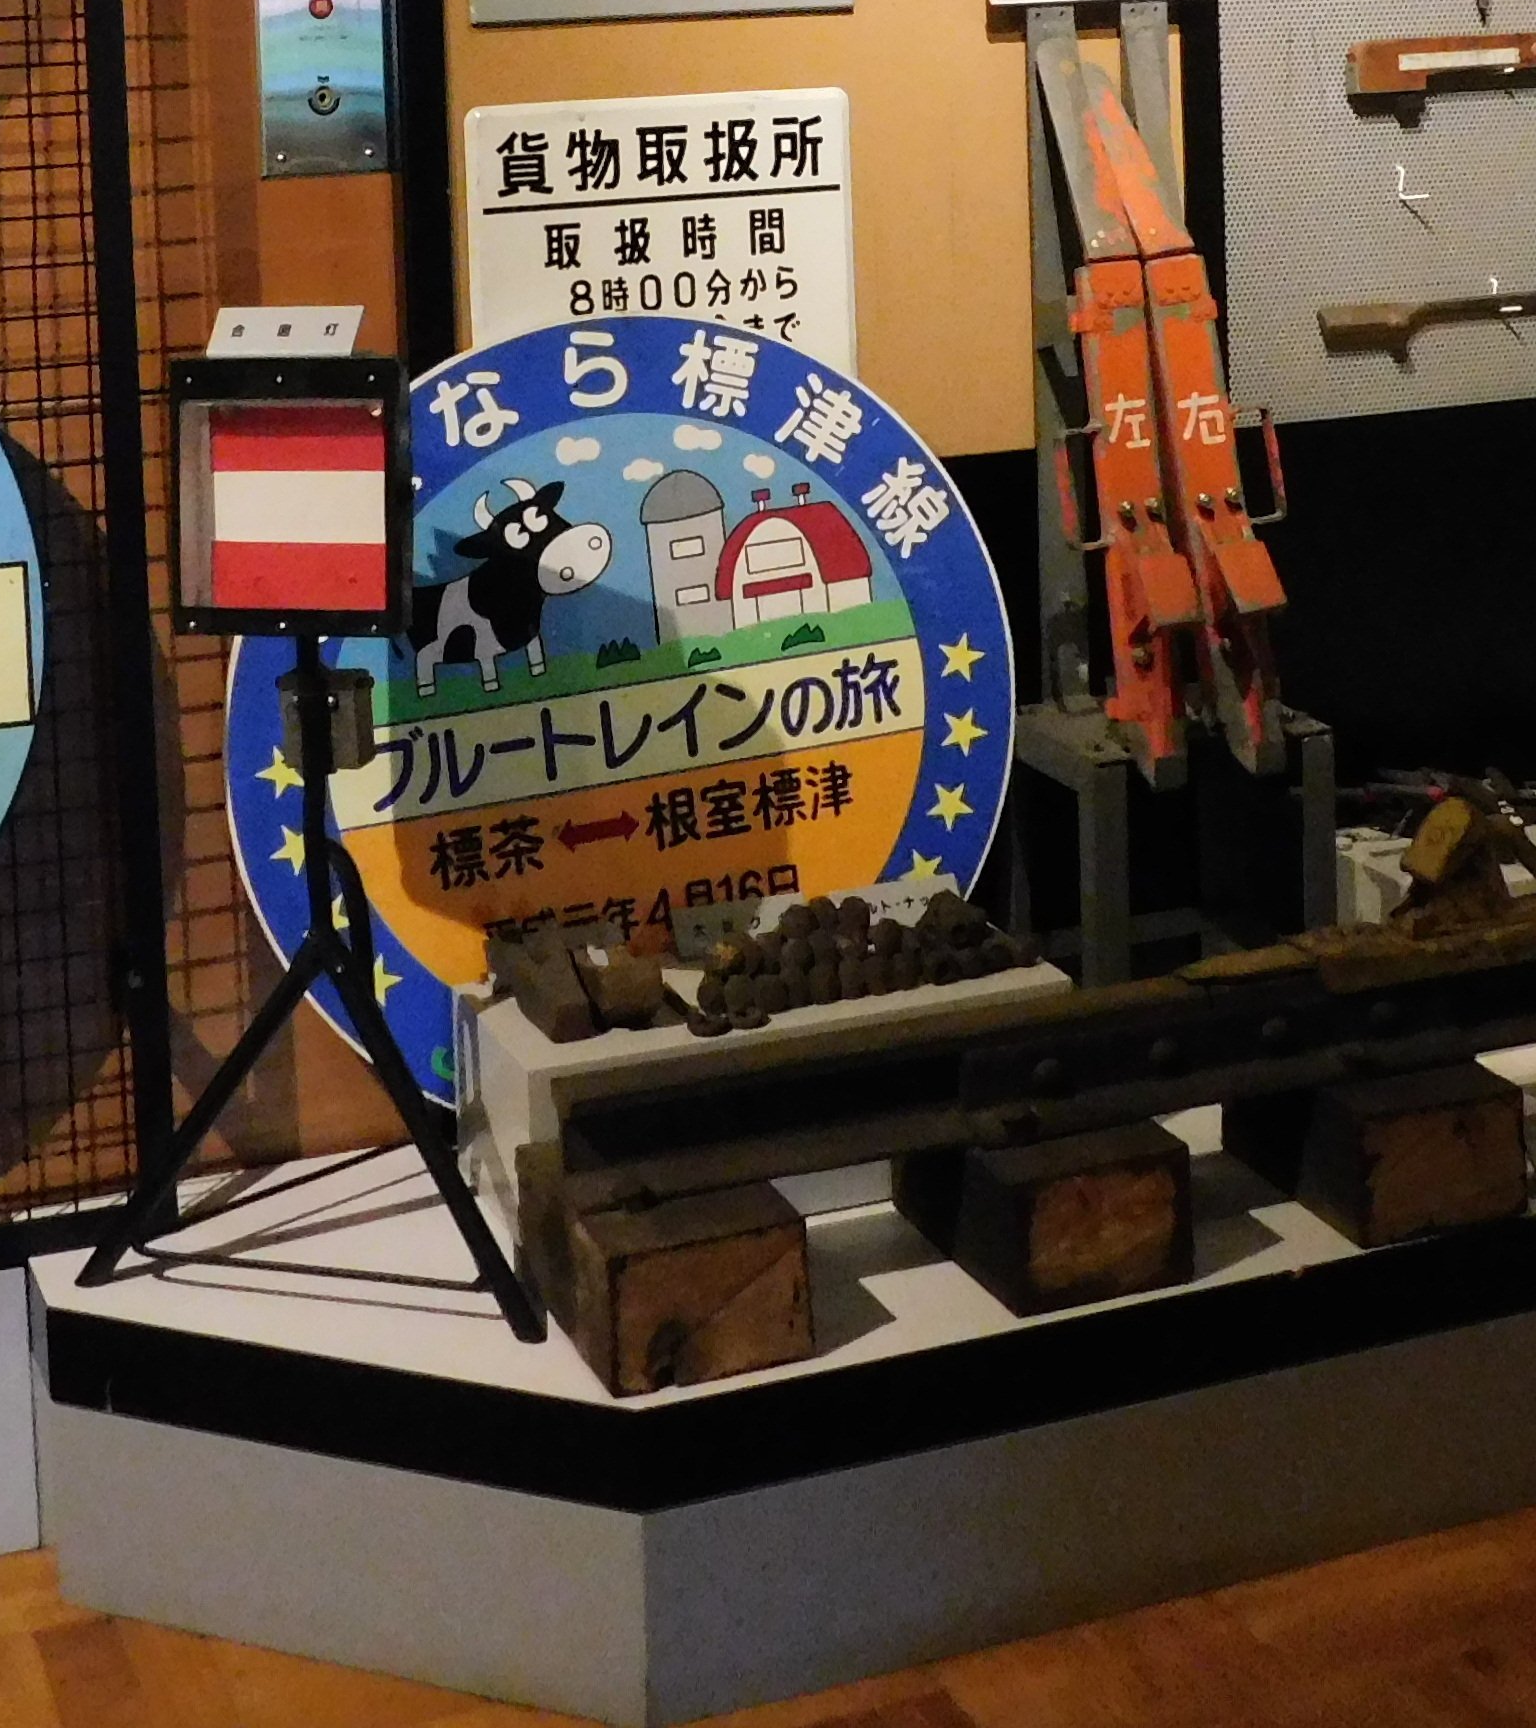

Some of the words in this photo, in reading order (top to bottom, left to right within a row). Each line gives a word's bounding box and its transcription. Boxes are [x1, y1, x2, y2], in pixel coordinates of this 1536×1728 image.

[496, 115, 824, 199] 貨物取扱所
[544, 209, 786, 270] 取扱時間
[570, 265, 799, 316] 8時00分から
[429, 329, 950, 560] なら標津線
[1104, 392, 1151, 449] 左
[1177, 391, 1227, 445] 右
[373, 652, 902, 813] ブルートレインの旅
[429, 818, 545, 891] 標茶
[645, 761, 854, 854] 根室標津
